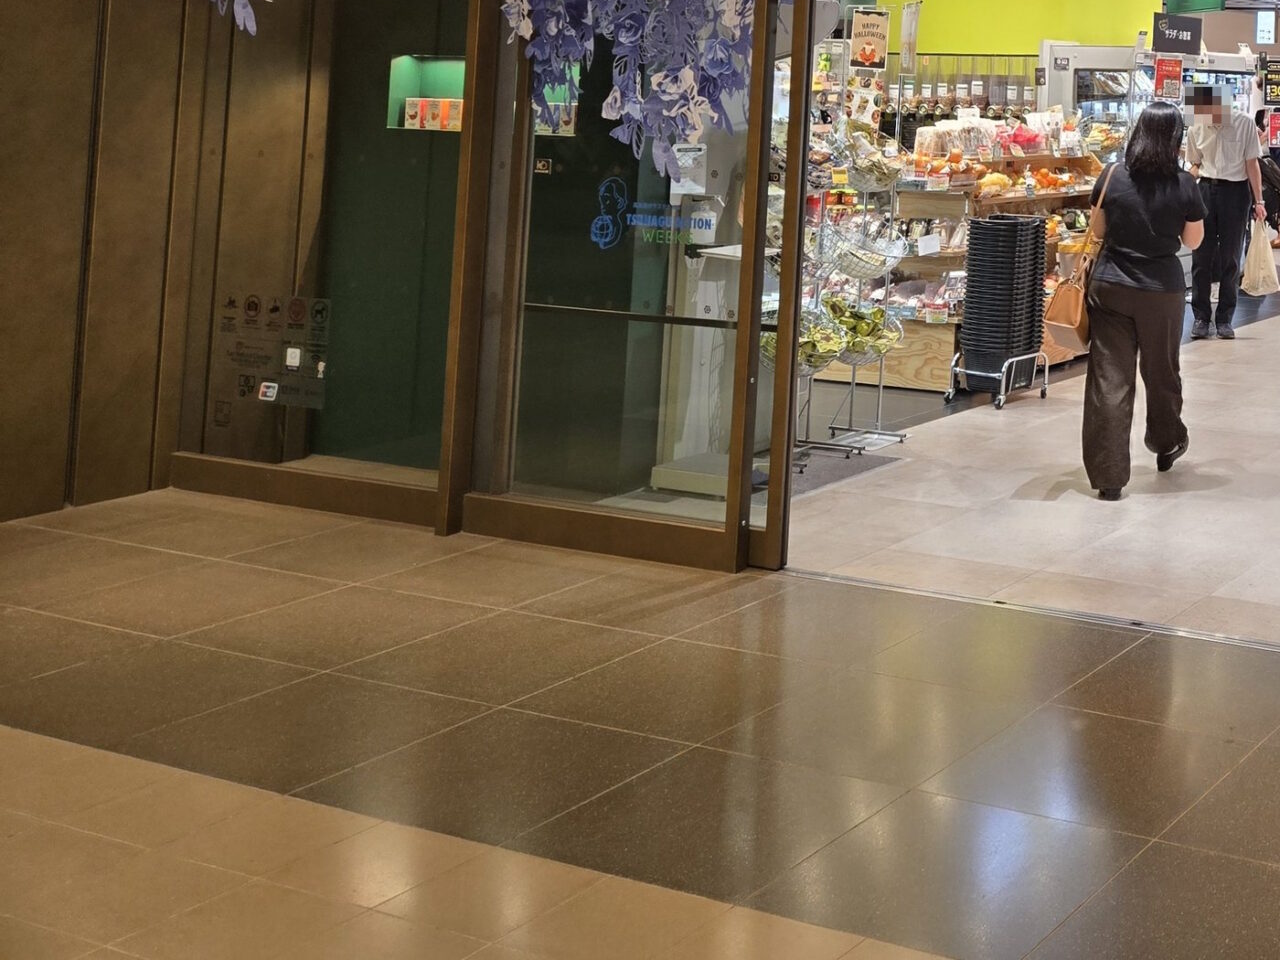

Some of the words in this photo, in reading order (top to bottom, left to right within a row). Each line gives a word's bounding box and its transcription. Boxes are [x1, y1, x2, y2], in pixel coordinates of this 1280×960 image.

[862, 22, 880, 30] HAPPY
[854, 30, 886, 41] HALLOWEEN
[642, 229, 694, 244] WEEKS
